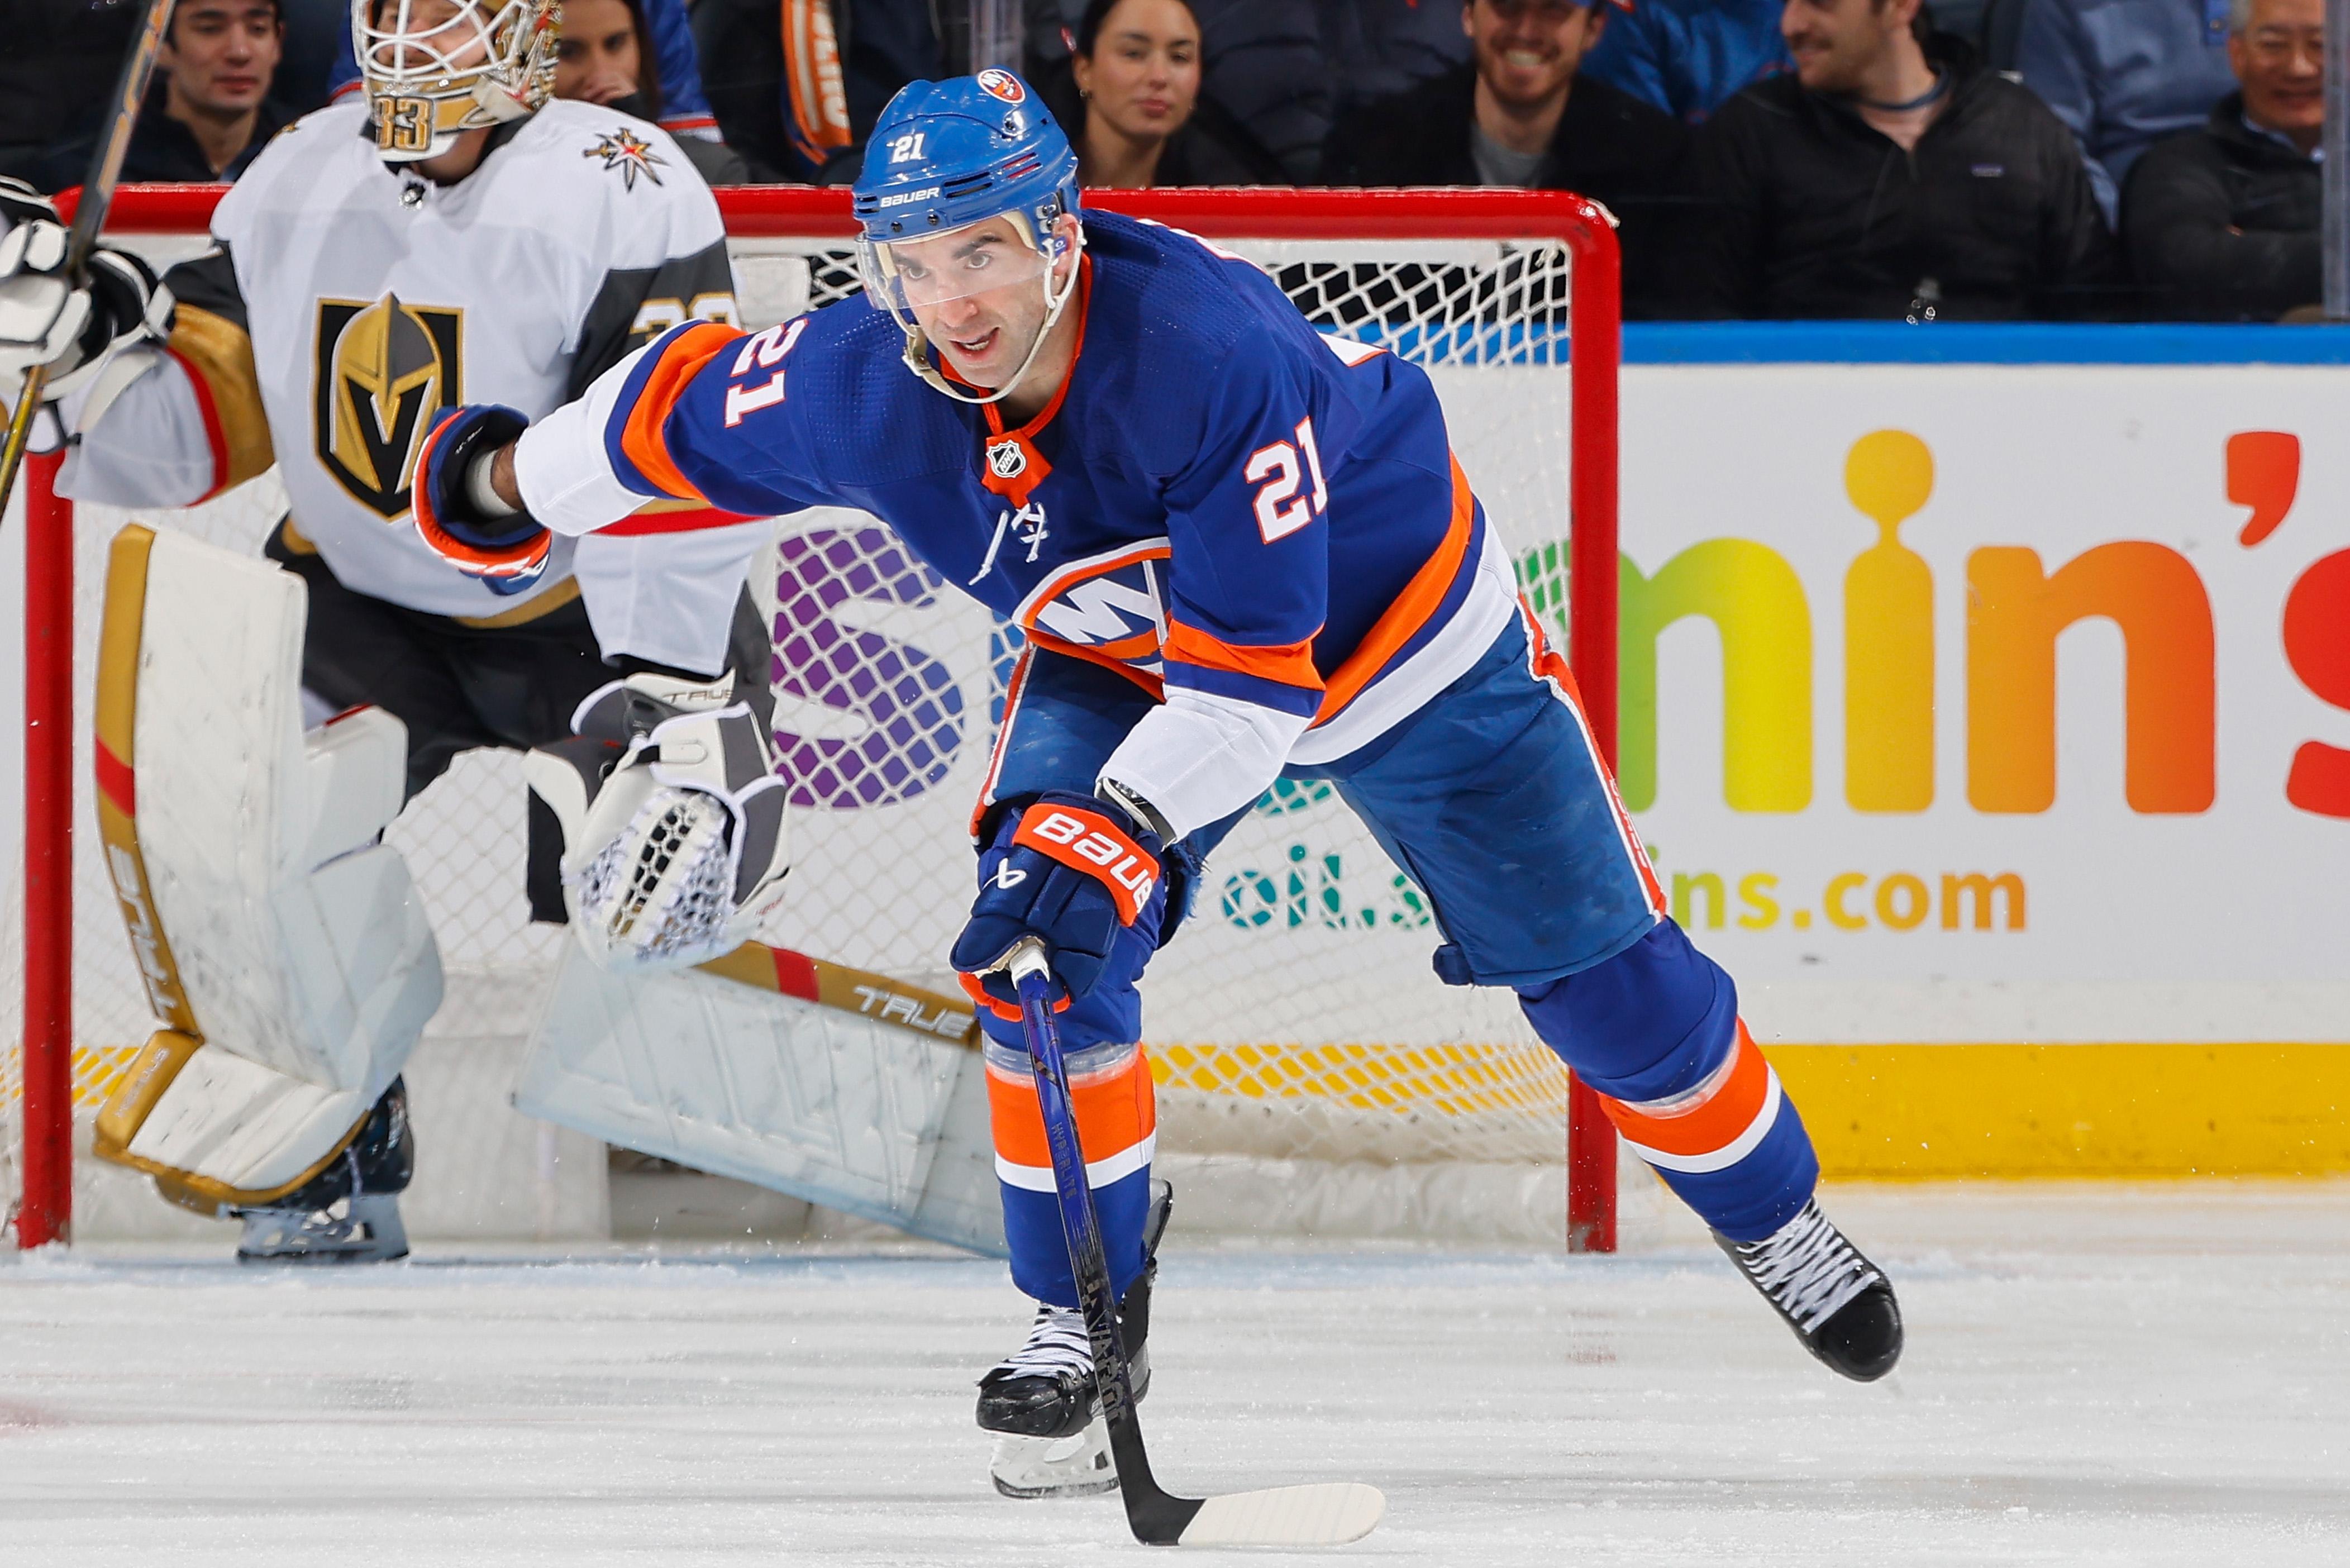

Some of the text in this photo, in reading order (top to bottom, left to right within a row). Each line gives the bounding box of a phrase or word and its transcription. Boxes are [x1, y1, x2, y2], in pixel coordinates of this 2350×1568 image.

[892, 133, 925, 163] 21
[880, 187, 940, 208] BAUER
[724, 318, 809, 428] 21
[999, 450, 1015, 471] NHL
[1244, 416, 1328, 545] 21
[854, 984, 974, 1039] TRUE
[1051, 1122, 1077, 1199] HYPERLITE
